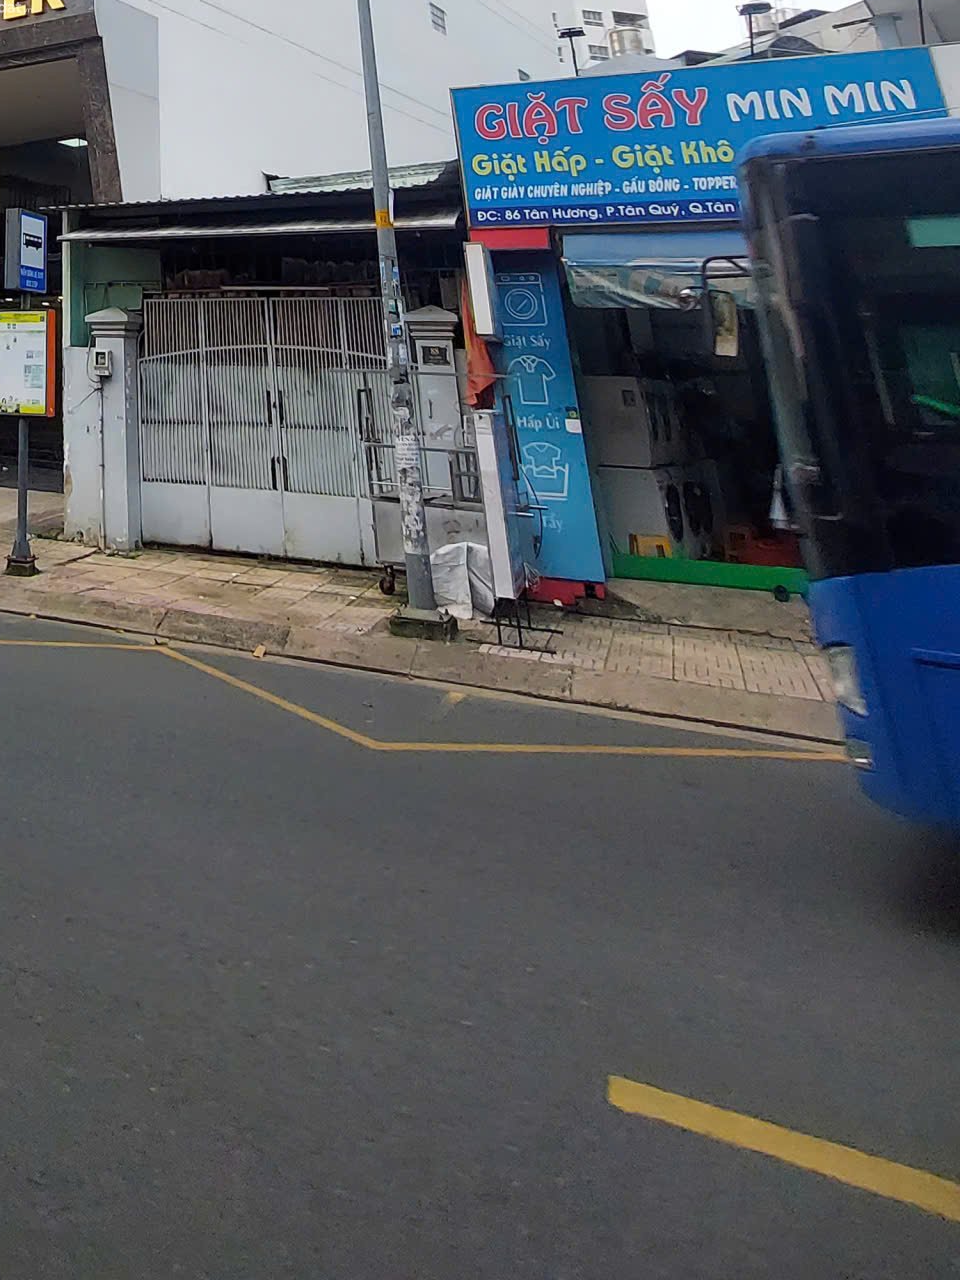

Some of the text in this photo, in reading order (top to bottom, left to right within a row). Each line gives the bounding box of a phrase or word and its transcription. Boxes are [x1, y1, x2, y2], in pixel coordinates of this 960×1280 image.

[474, 72, 917, 145] GIẶT SẤY MIN MIN
[472, 151, 527, 182] Giặt
[533, 145, 587, 177] Hấp
[611, 142, 675, 174] Giặt
[680, 140, 735, 165] Khô
[474, 184, 499, 202] GIẶT
[500, 183, 525, 199] GIÀY
[527, 181, 568, 199] CHUYÊN
[571, 179, 612, 197] NGHIỆP
[622, 175, 646, 194] GẤU
[648, 176, 680, 193] BÔNG
[692, 175, 738, 191] TOPPER
[477, 210, 501, 221] ĐC:
[505, 210, 521, 220] 86
[523, 208, 549, 220] Tân
[552, 207, 603, 221] Hương,
[606, 205, 645, 217] P.Tân
[688, 201, 736, 214] Q.Tân
[503, 332, 552, 351] Giặt Sấy
[516, 414, 543, 432] Hấp
